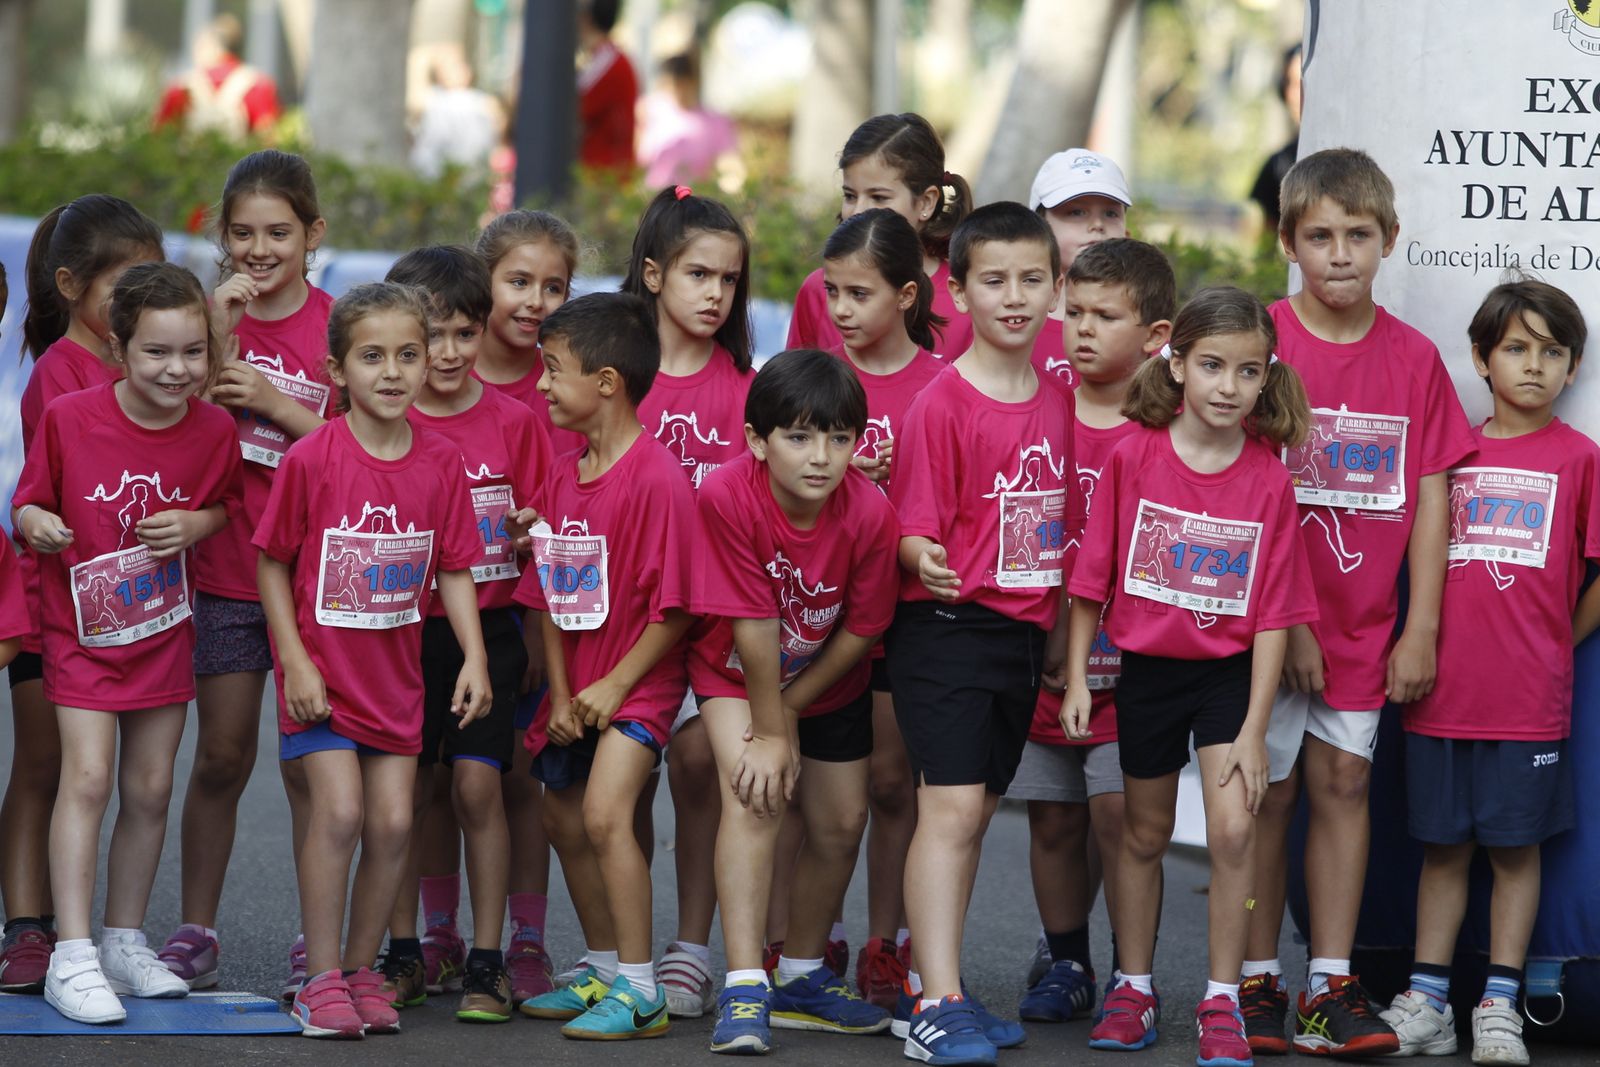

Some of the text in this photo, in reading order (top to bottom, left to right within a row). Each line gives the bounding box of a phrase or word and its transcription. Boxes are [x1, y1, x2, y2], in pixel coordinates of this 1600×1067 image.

[1524, 78, 1600, 114] EX
[1461, 184, 1528, 221] DE
[1407, 240, 1521, 276] Concejalía
[1530, 244, 1561, 270] de
[1340, 418, 1372, 429] CARRERA
[253, 426, 285, 443] BLANCA
[1324, 441, 1396, 473] 1691
[691, 462, 703, 489] 4
[1345, 472, 1374, 483] JUANJO
[1481, 473, 1512, 484] CARRERA
[1512, 475, 1550, 489] SOLIDARIA
[476, 491, 508, 502] SOLIDARIA
[1466, 497, 1545, 529] 1770
[1188, 520, 1221, 533] CARRERA
[1222, 525, 1255, 537] SOLIDARIA
[1466, 525, 1533, 539] DANIEL ROMERO
[485, 545, 502, 555] RUIZ
[565, 542, 599, 551] SOLIDARIA
[1170, 542, 1249, 578] 1734
[115, 560, 181, 607] 1518
[364, 561, 426, 592] 1804
[538, 564, 600, 593] 1609
[1192, 575, 1218, 587] ELENA
[144, 596, 164, 611] ELENA
[799, 607, 809, 626] 4
